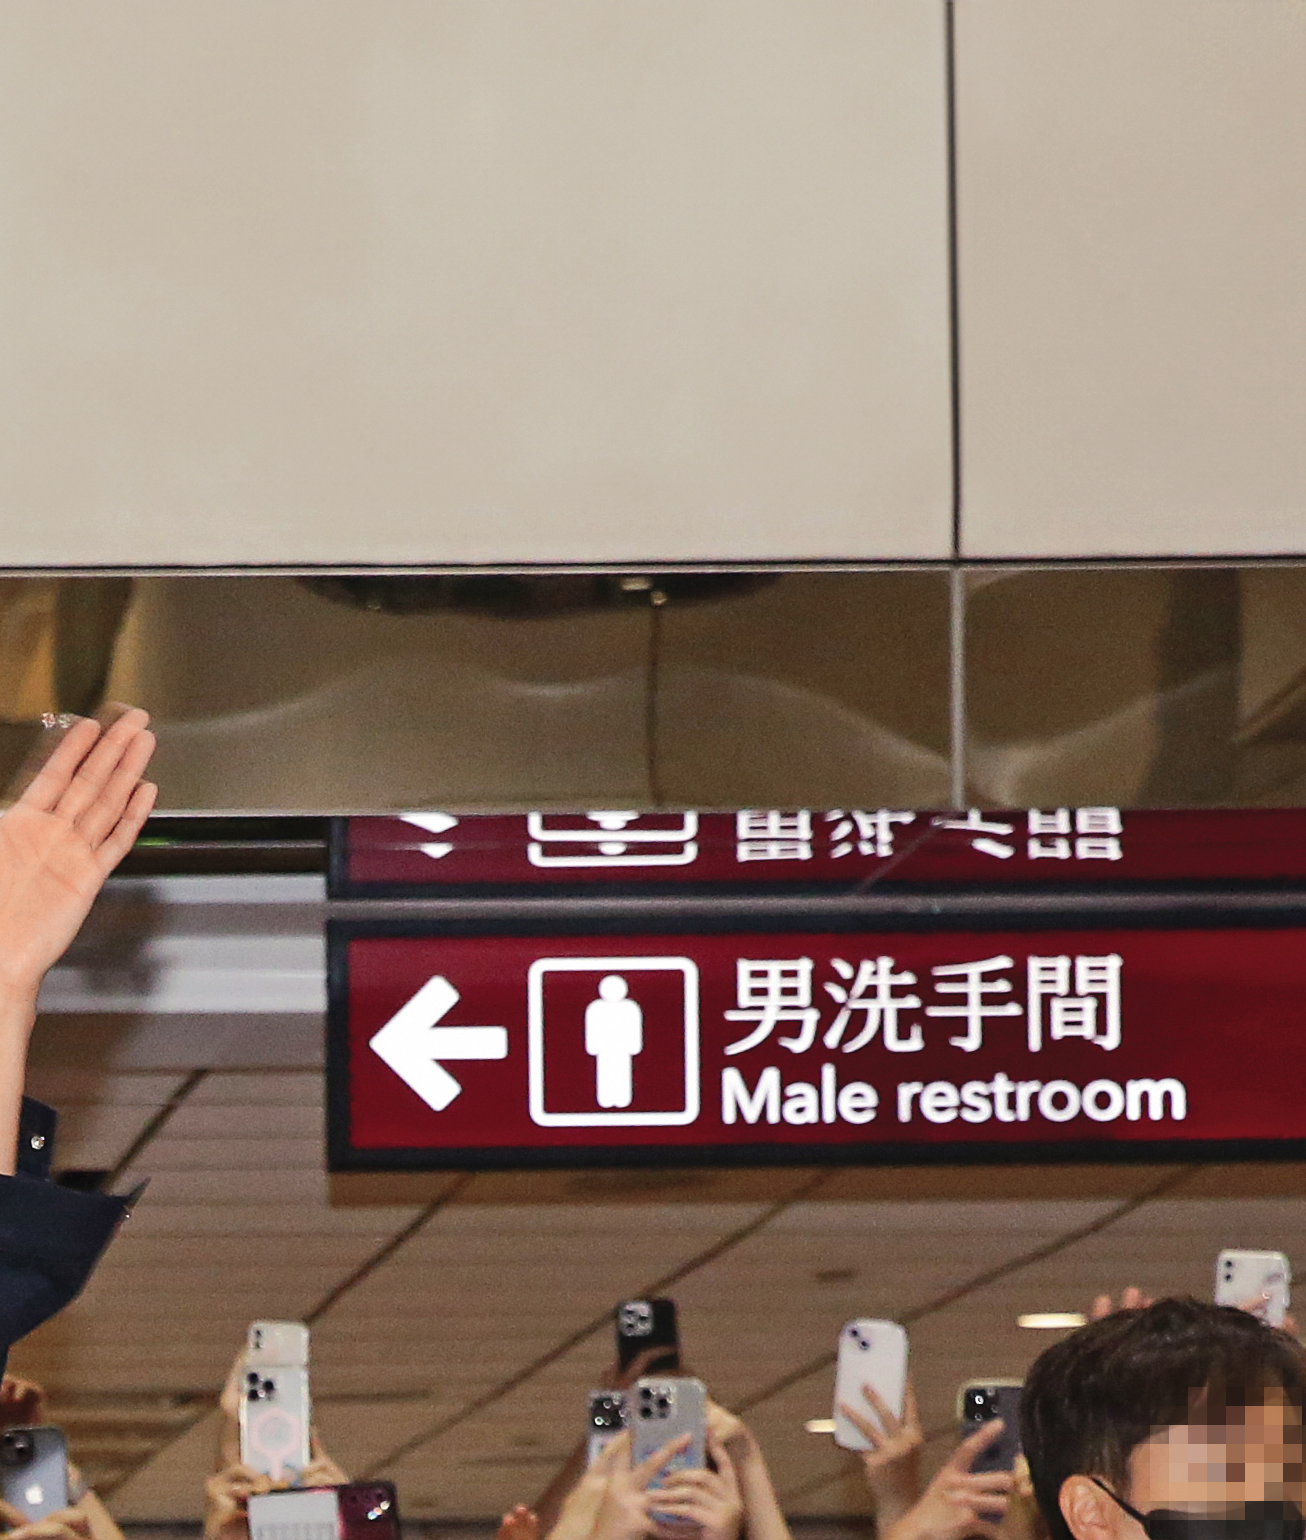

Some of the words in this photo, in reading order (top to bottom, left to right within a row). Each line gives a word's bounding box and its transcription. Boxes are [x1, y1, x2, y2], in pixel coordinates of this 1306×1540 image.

[723, 955, 1124, 1056] 男洗手間
[720, 1062, 880, 1125] Male
[896, 1072, 1188, 1124] restroom
